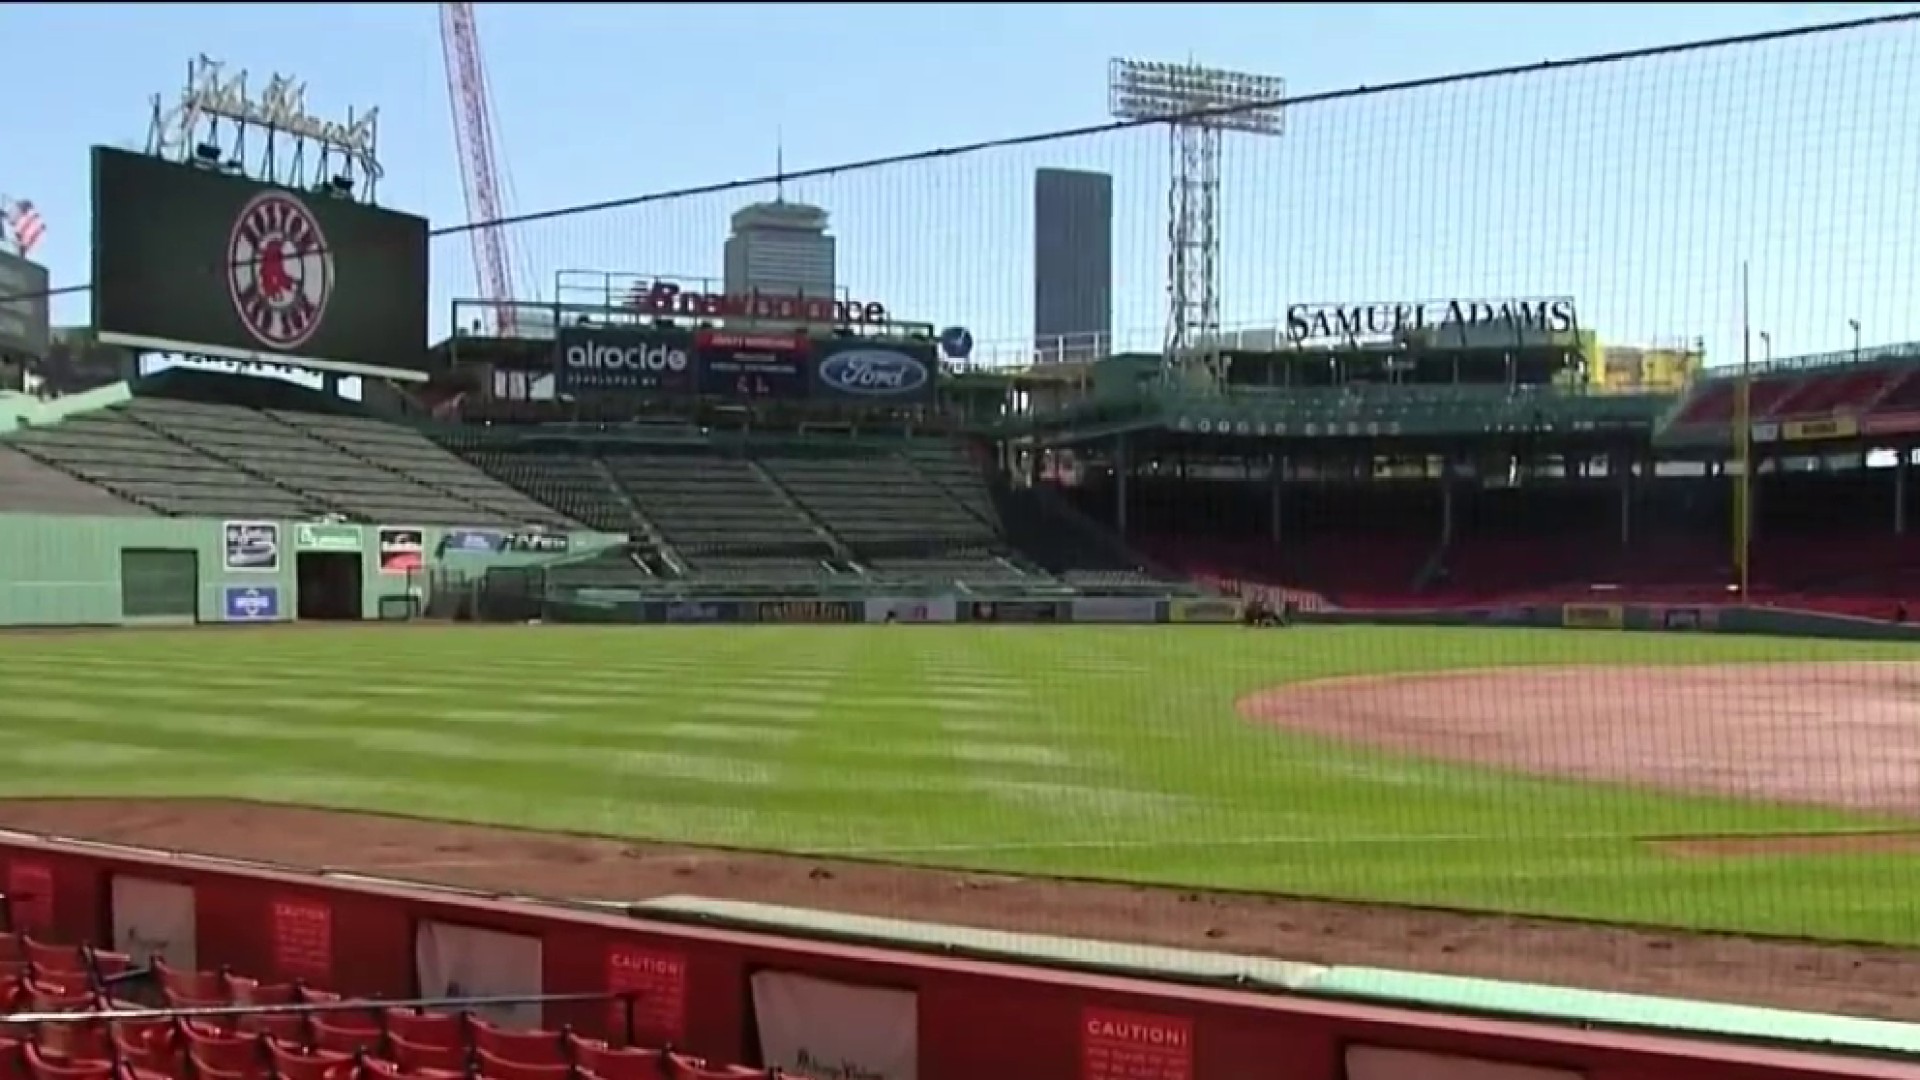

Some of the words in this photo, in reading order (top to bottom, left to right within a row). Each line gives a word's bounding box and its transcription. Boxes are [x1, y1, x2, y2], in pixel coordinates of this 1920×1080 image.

[1287, 303, 1428, 342] SAMUEL
[1440, 300, 1571, 334] ADAMS
[840, 357, 906, 389] Ford
[1087, 1019, 1187, 1048] CAUTION!
